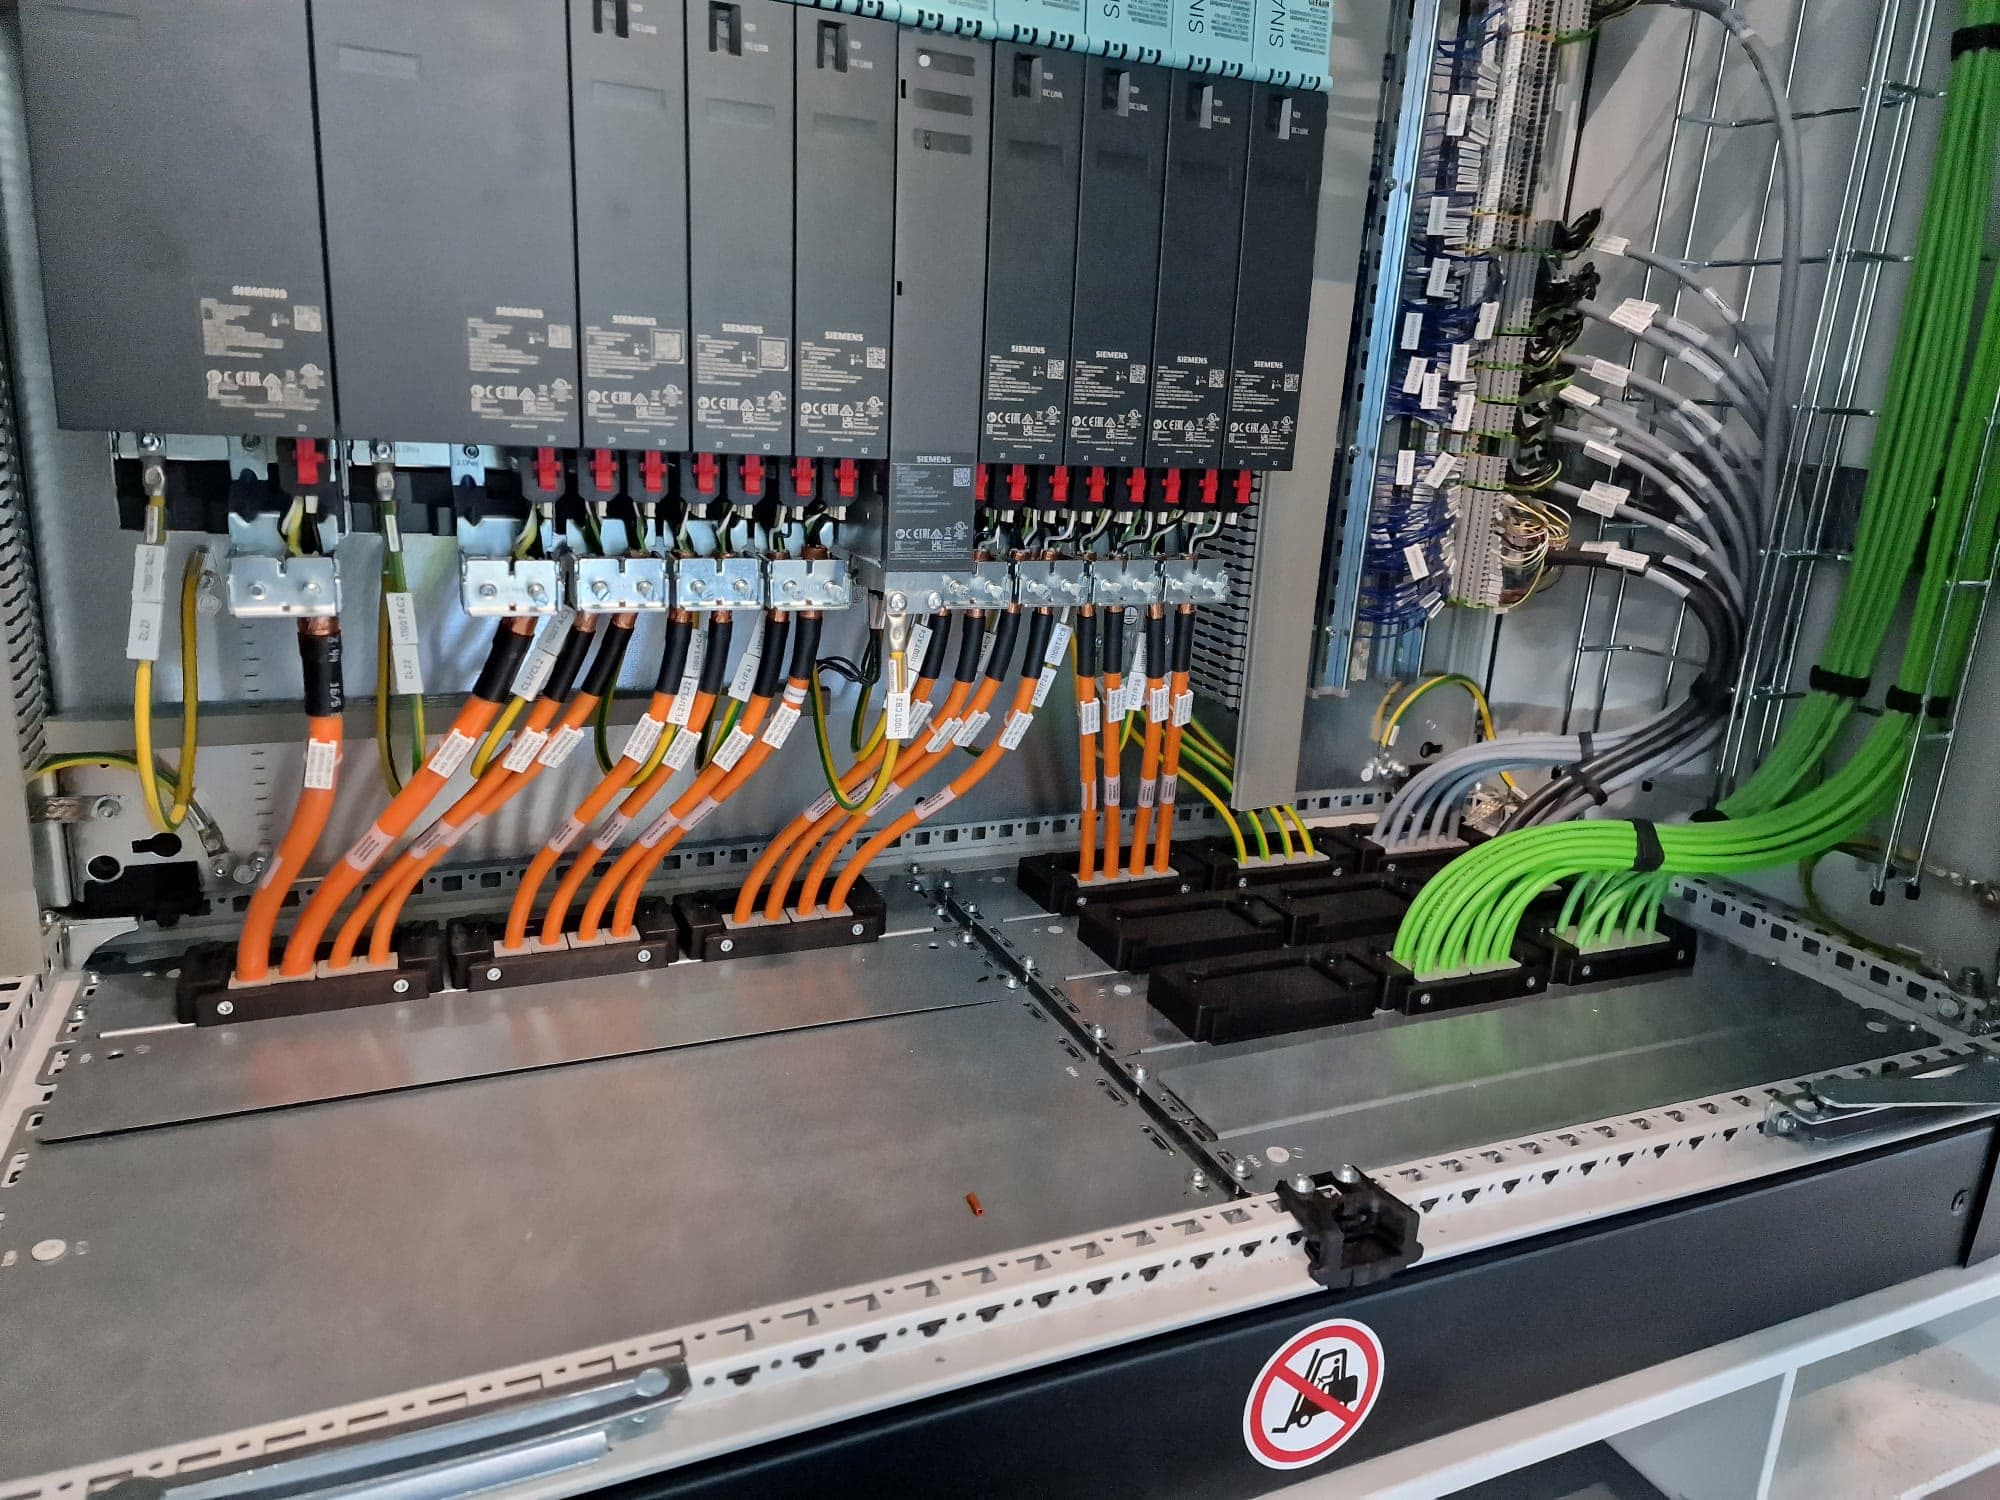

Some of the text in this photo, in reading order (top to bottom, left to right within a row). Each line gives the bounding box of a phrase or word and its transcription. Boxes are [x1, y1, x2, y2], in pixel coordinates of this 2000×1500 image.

[721, 322, 764, 335] SIEMENS
[824, 330, 864, 342] SIEMENS
[1010, 344, 1046, 354] SIEMENS
[1095, 350, 1129, 360] SIEMENS
[1176, 355, 1208, 365] SIEMENS
[1253, 360, 1284, 369] SIEMENS
[916, 455, 952, 464] SIEMENS
[520, 658, 545, 692] CL1/CL2
[675, 680, 692, 723] FL21/FL22
[894, 697, 904, 737] -1100TCB2
